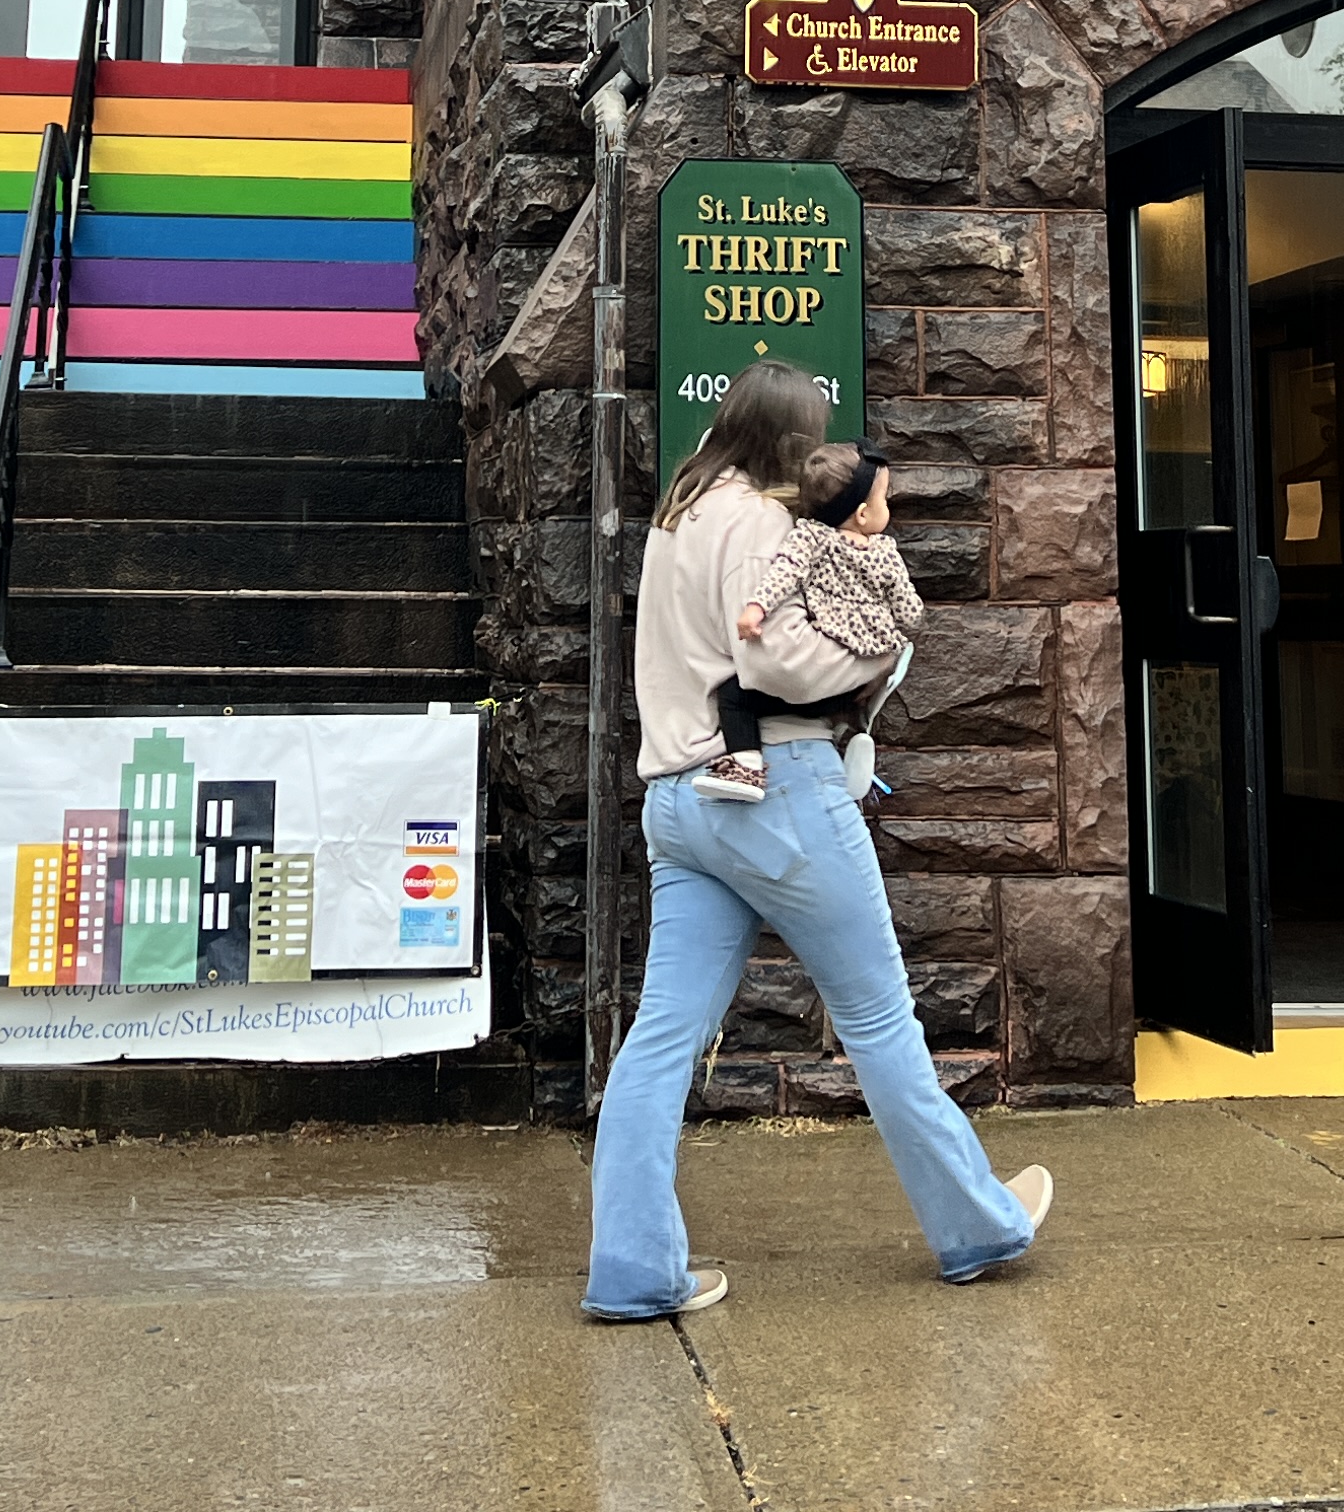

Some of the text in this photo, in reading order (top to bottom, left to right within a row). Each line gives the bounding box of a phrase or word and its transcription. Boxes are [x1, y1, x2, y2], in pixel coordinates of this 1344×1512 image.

[786, 12, 961, 43] Church Entrance
[836, 46, 919, 73] Elevator
[697, 194, 827, 223] St. Luke's
[677, 234, 848, 274] THRIFT
[704, 284, 821, 324] SHOP
[677, 373, 731, 403] 409
[415, 831, 449, 846] VISA
[403, 877, 457, 889] MasterCard
